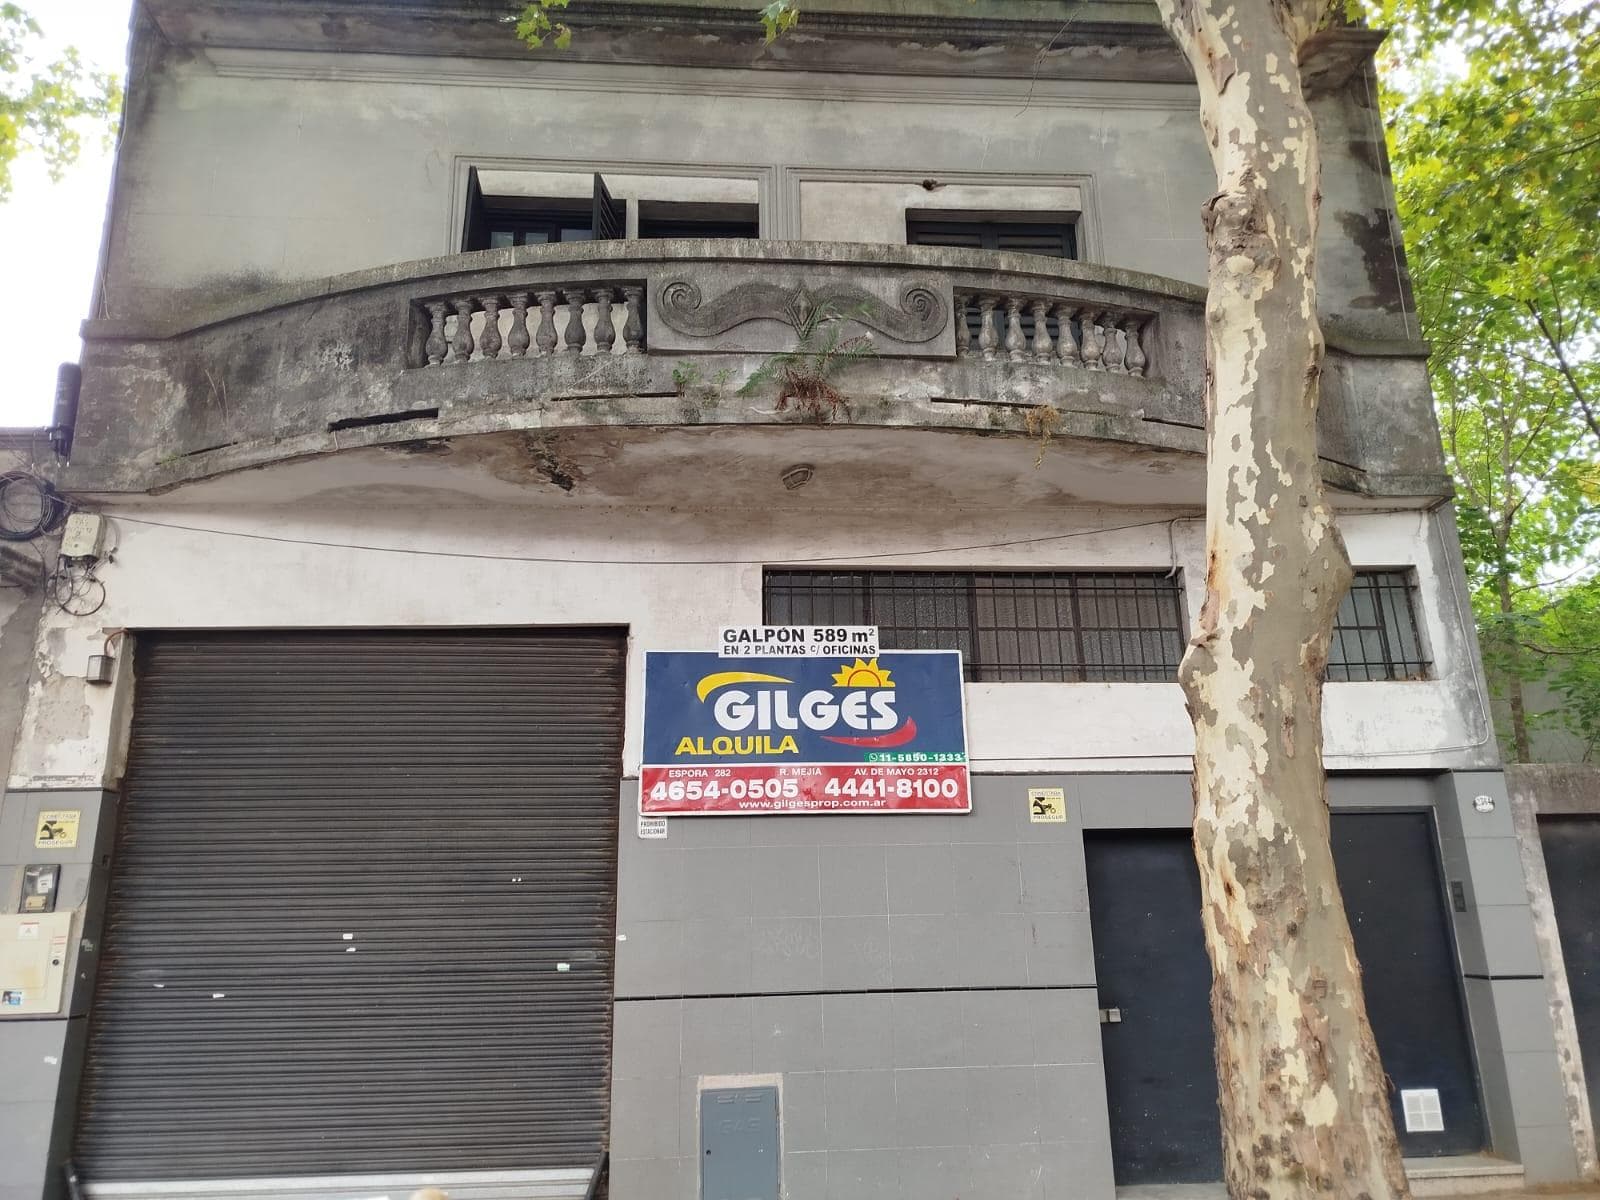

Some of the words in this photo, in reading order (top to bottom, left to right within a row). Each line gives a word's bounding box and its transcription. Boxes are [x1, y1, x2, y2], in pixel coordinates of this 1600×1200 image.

[723, 627, 805, 643] GALPÓN
[813, 628, 847, 642] 589
[724, 645, 739, 655] EN
[744, 645, 751, 655] 2
[754, 645, 806, 655] PLANTAS
[823, 644, 876, 655] OFICINAS
[714, 690, 899, 731] GILGES
[675, 735, 799, 756] ALQUILA
[668, 769, 709, 778] ESPORA
[714, 768, 732, 777] 282
[779, 768, 789, 776] R.
[854, 767, 868, 776] AV.
[870, 767, 884, 776] DE
[886, 767, 915, 776] MAYO
[917, 767, 939, 776] 2312
[650, 778, 799, 801] 4654-0505
[824, 777, 959, 799] 4441-8100
[738, 798, 887, 810] www.gilgesprop.com.ar
